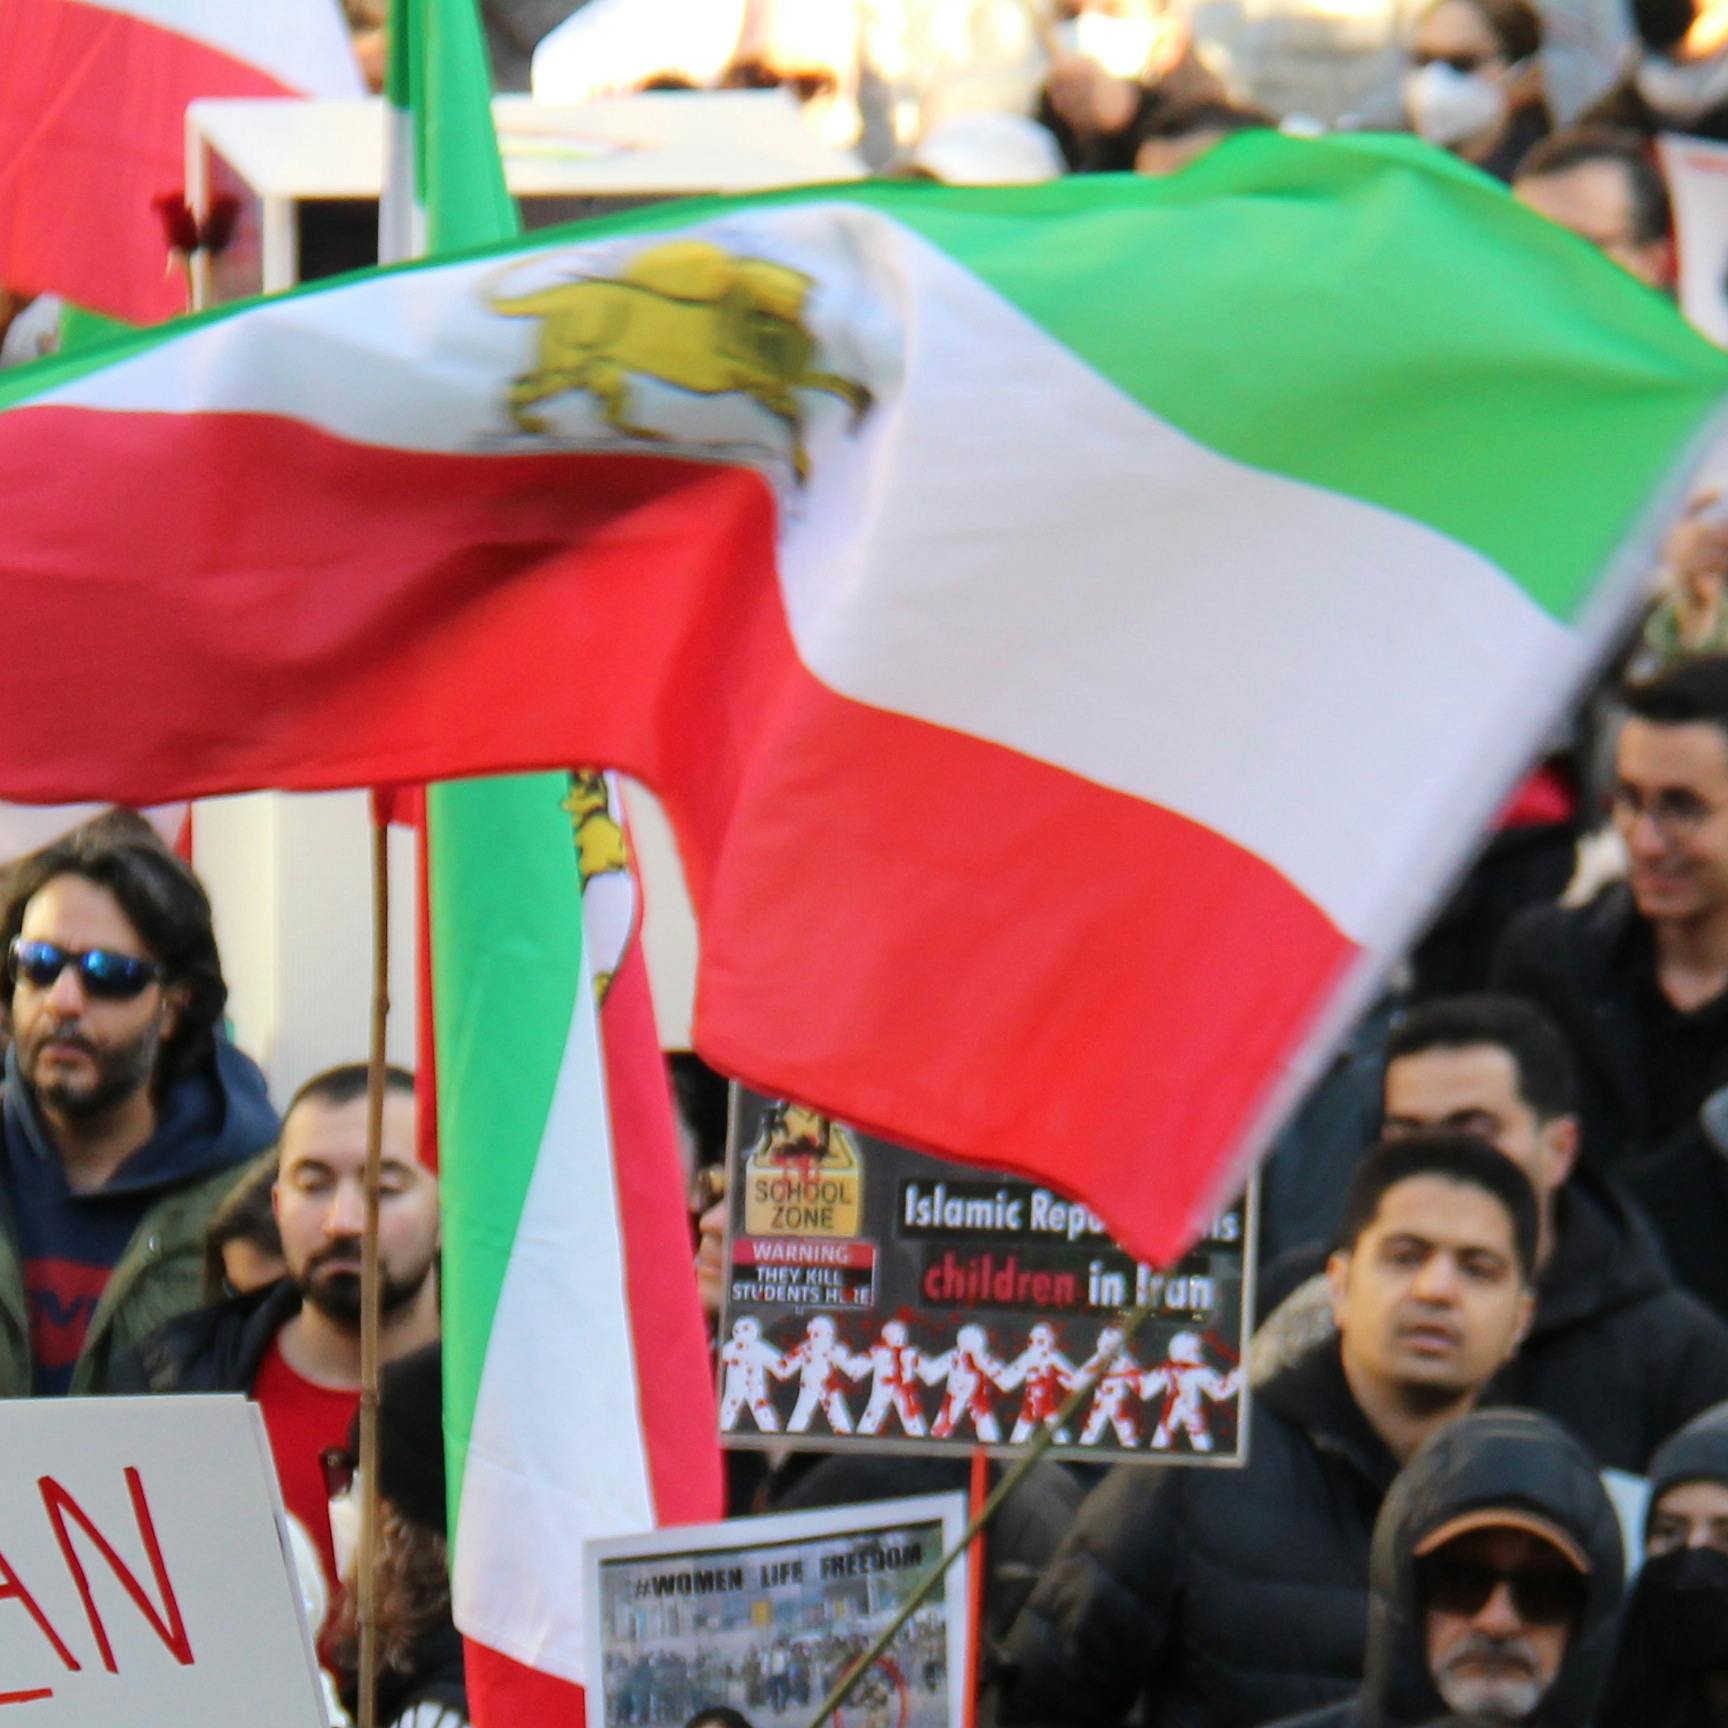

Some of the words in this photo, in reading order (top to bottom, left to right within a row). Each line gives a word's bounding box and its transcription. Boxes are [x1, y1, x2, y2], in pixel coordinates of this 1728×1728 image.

[754, 1179, 851, 1206] SCHOOL
[772, 1205, 834, 1230] ZONE
[904, 1183, 1023, 1231] Islamic
[752, 1242, 849, 1265] WARNING
[757, 1266, 802, 1284] THEY
[806, 1268, 843, 1287] KILL
[924, 1251, 1076, 1307] children
[1088, 1258, 1124, 1308] in
[1135, 1261, 1215, 1312] Iran
[731, 1282, 821, 1304] STUDENTS
[825, 1286, 872, 1306] HRE
[634, 1566, 744, 1600] #WOMEN
[760, 1559, 804, 1589] LIFE
[819, 1541, 924, 1580] FREEDOM
